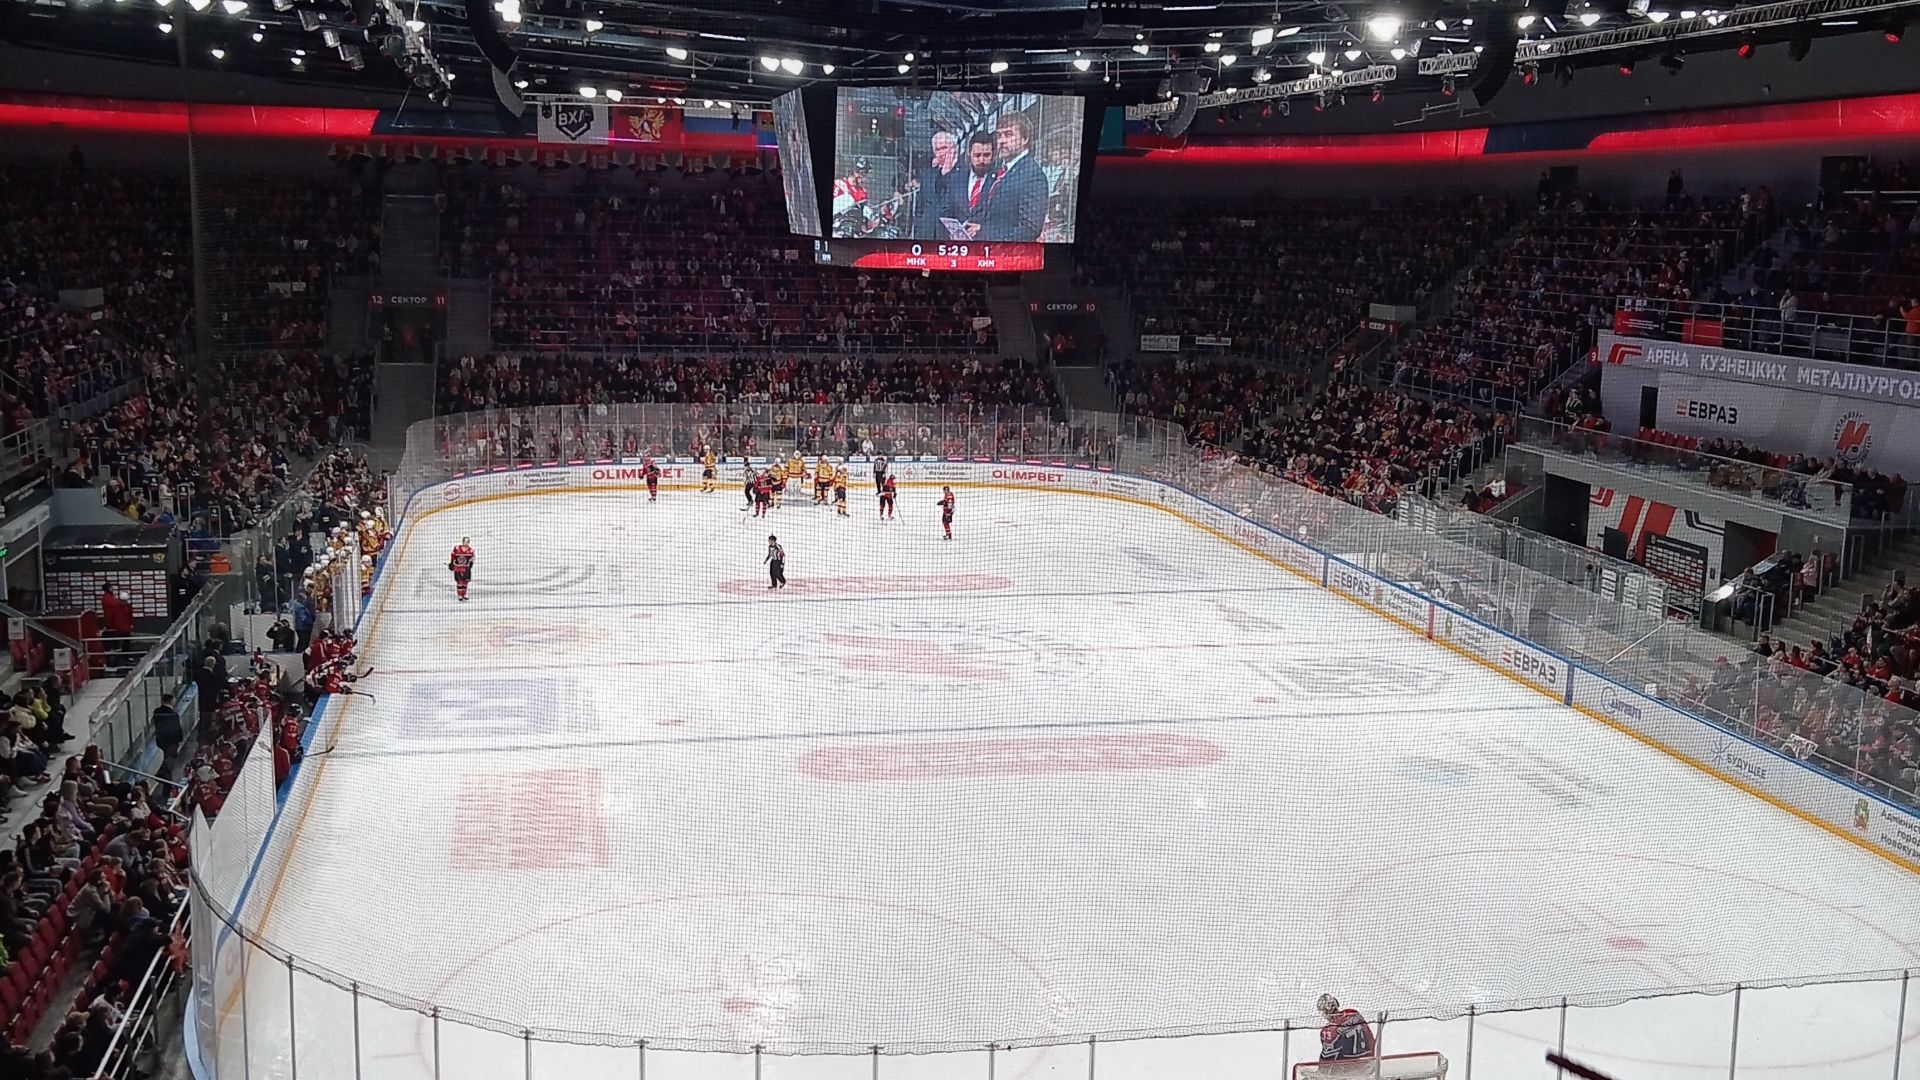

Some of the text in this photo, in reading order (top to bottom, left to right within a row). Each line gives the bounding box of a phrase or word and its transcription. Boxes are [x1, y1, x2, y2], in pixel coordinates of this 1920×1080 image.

[911, 244, 922, 256] 0
[938, 245, 968, 257] 5:29
[983, 246, 989, 258] 1
[950, 259, 957, 268] 3
[372, 295, 445, 305] 12 СЕКТОР 11
[1030, 303, 1096, 312] 11 СЕКТОР 10
[1646, 348, 1920, 400] АРЕНА КУЗНЕЦКИХ МЕТАЛЛУРГОВ
[1688, 400, 1738, 425] ЕВРАЗ
[592, 467, 684, 480] OLIMET
[992, 469, 1065, 483] OLIMPBET
[1341, 571, 1371, 597] ЕВРАЗ
[1513, 650, 1557, 684] ЕВРАЗ
[1727, 753, 1767, 780] БУДУЩЕЕ
